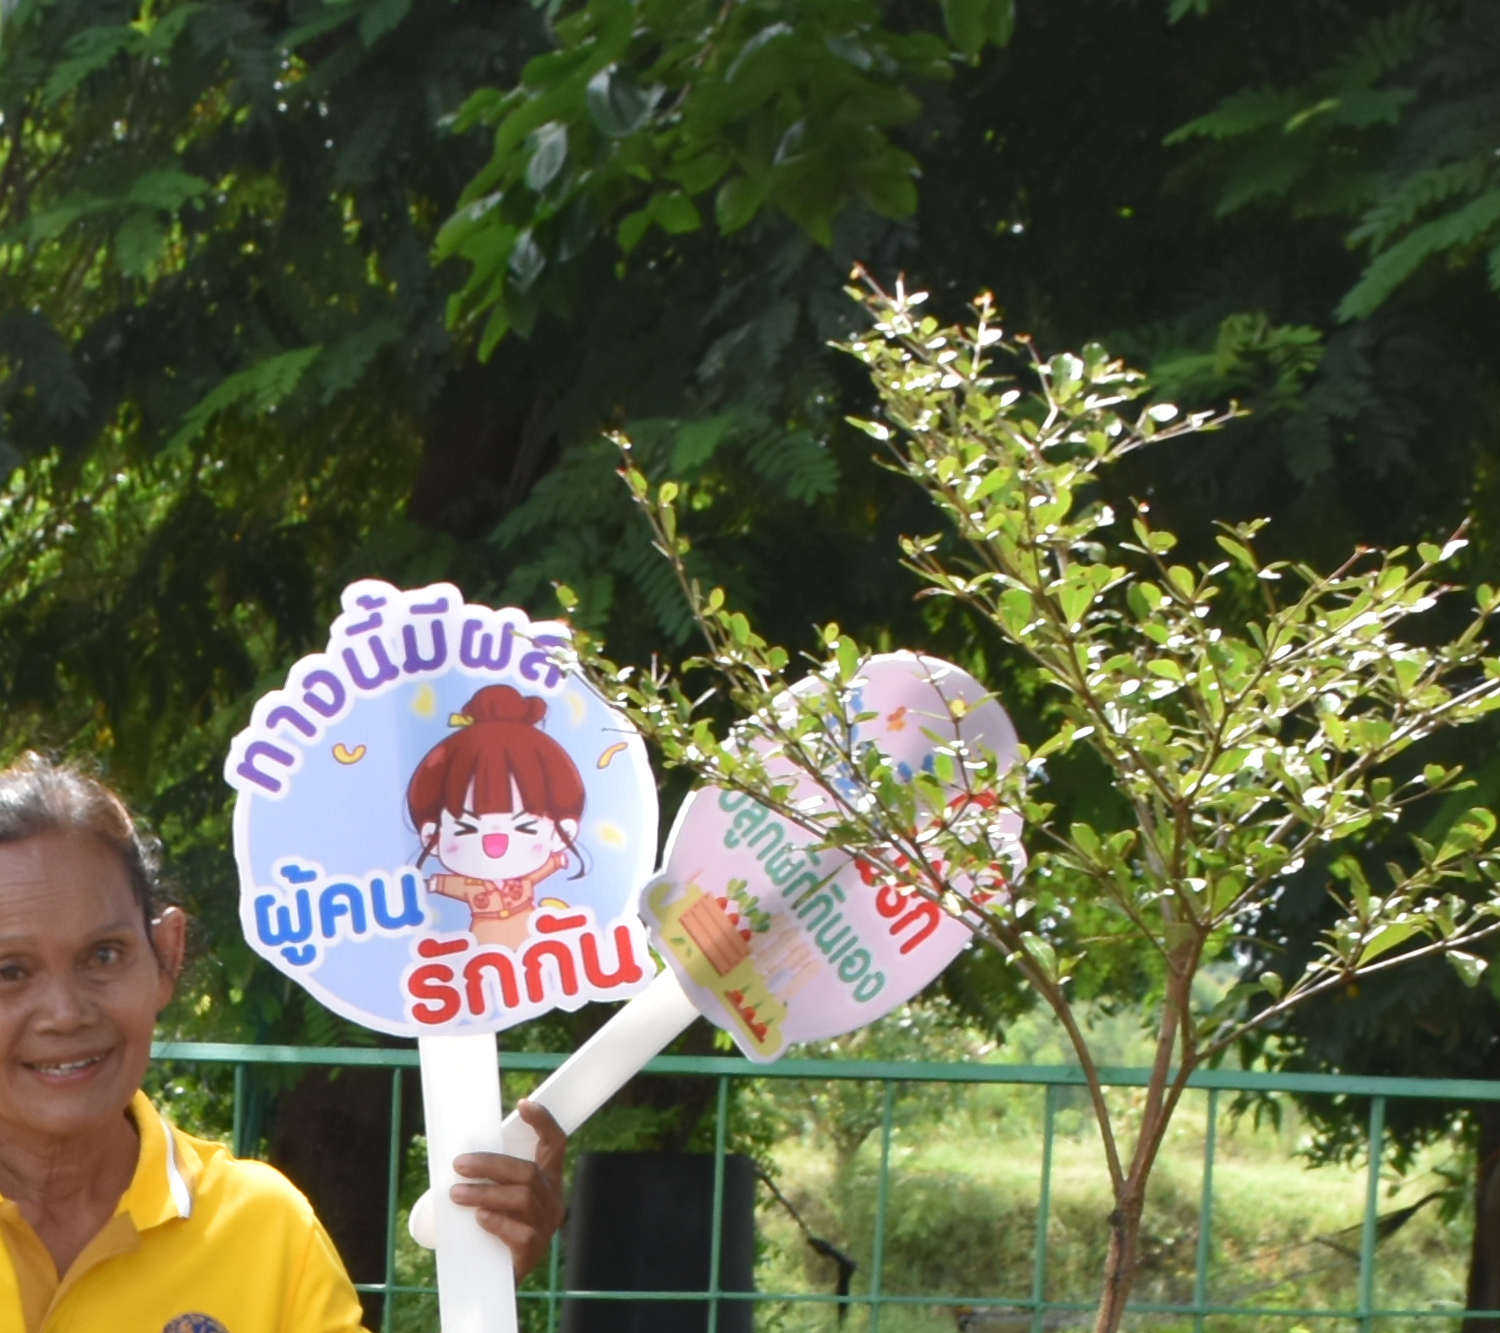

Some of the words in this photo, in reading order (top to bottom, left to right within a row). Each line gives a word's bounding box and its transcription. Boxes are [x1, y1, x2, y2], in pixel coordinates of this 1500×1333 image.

[253, 865, 425, 966] ผู้คน
[407, 913, 643, 1024] รักกัน
